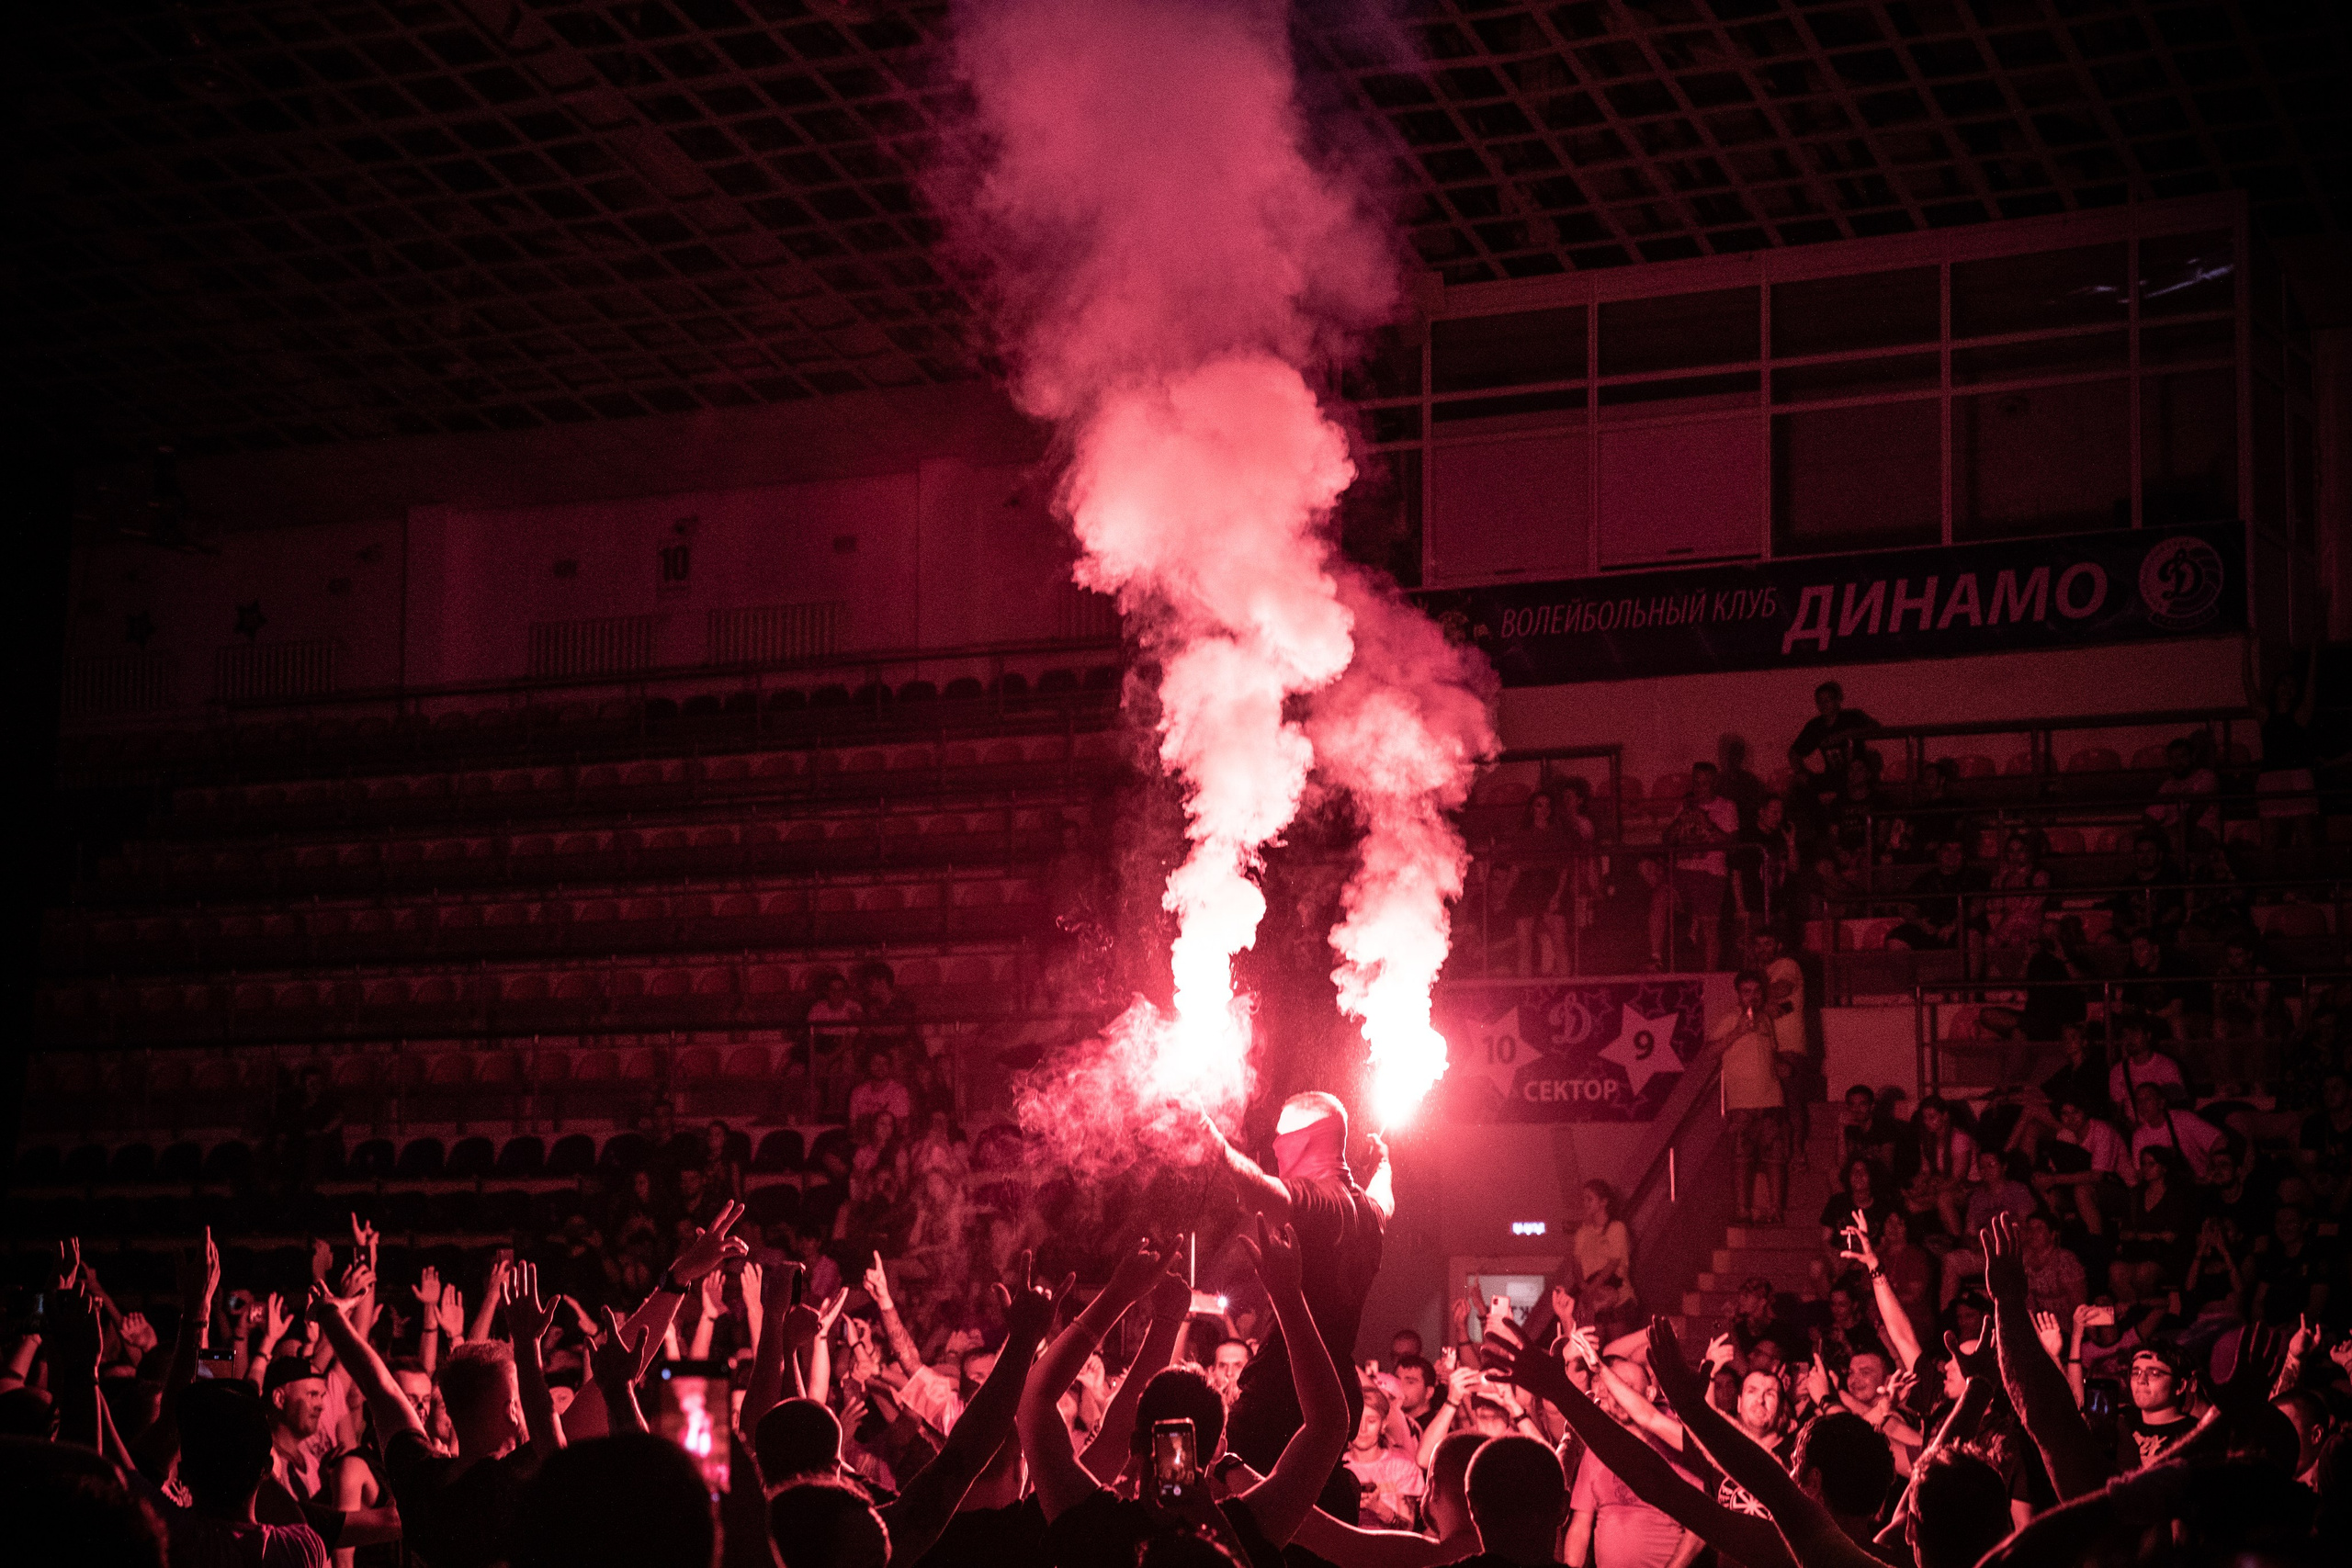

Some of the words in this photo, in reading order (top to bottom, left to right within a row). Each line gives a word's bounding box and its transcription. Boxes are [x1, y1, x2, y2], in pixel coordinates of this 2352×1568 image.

[661, 546, 687, 581] 10
[1501, 589, 1706, 637] ВОЛЕЙБОЛЬНЫЙ
[1713, 588, 1777, 621] КЛУБ
[1781, 562, 2109, 653] ДИНАМО
[1483, 1035, 1517, 1064] 10
[1634, 1030, 1655, 1060] 9
[1523, 1079, 1619, 1102] СЕКТОР
